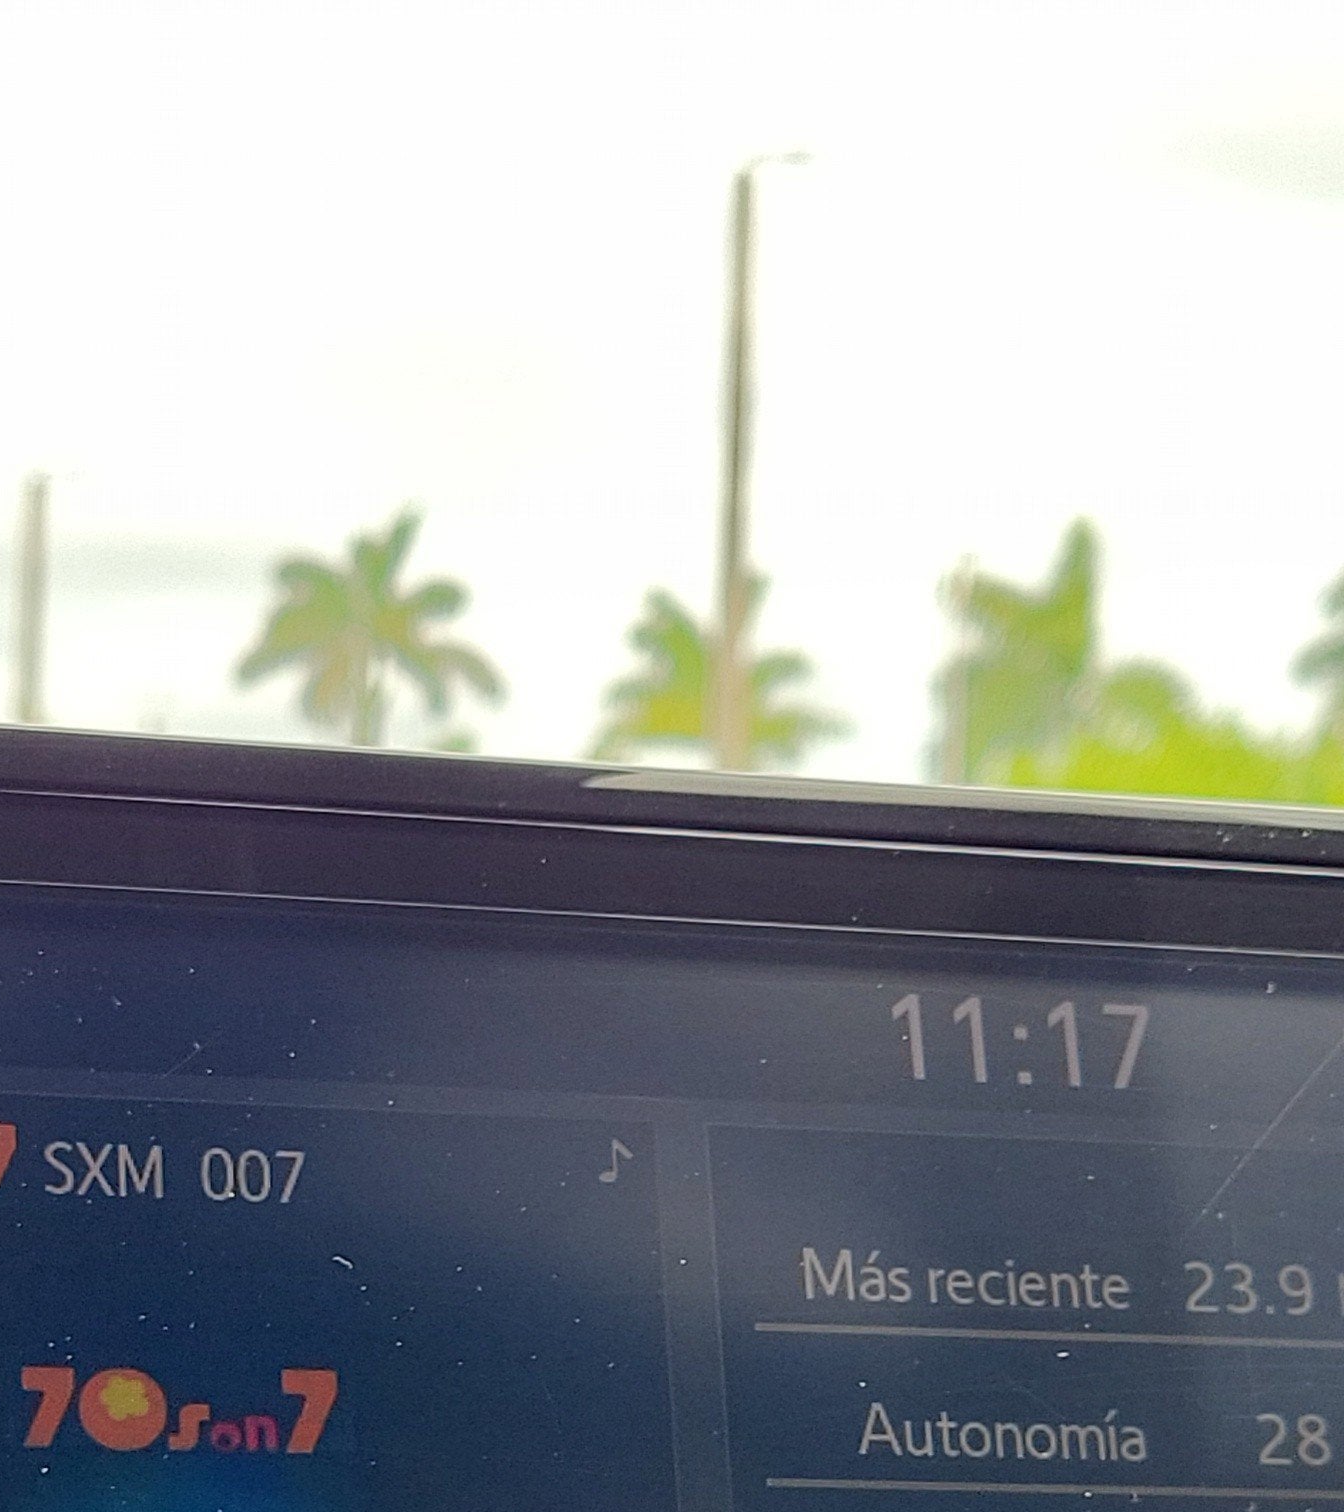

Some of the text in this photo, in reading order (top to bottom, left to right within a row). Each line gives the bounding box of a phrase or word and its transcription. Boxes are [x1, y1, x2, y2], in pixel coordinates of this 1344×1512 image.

[891, 993, 1149, 1089] 11:17
[44, 1141, 164, 1200] SXM
[200, 1147, 306, 1203] 007
[800, 1246, 912, 1303] Más
[927, 1258, 1131, 1310] reciente
[1182, 1259, 1315, 1317] 23.9
[857, 1400, 1148, 1464] Autonomía
[1256, 1412, 1332, 1468] 28
